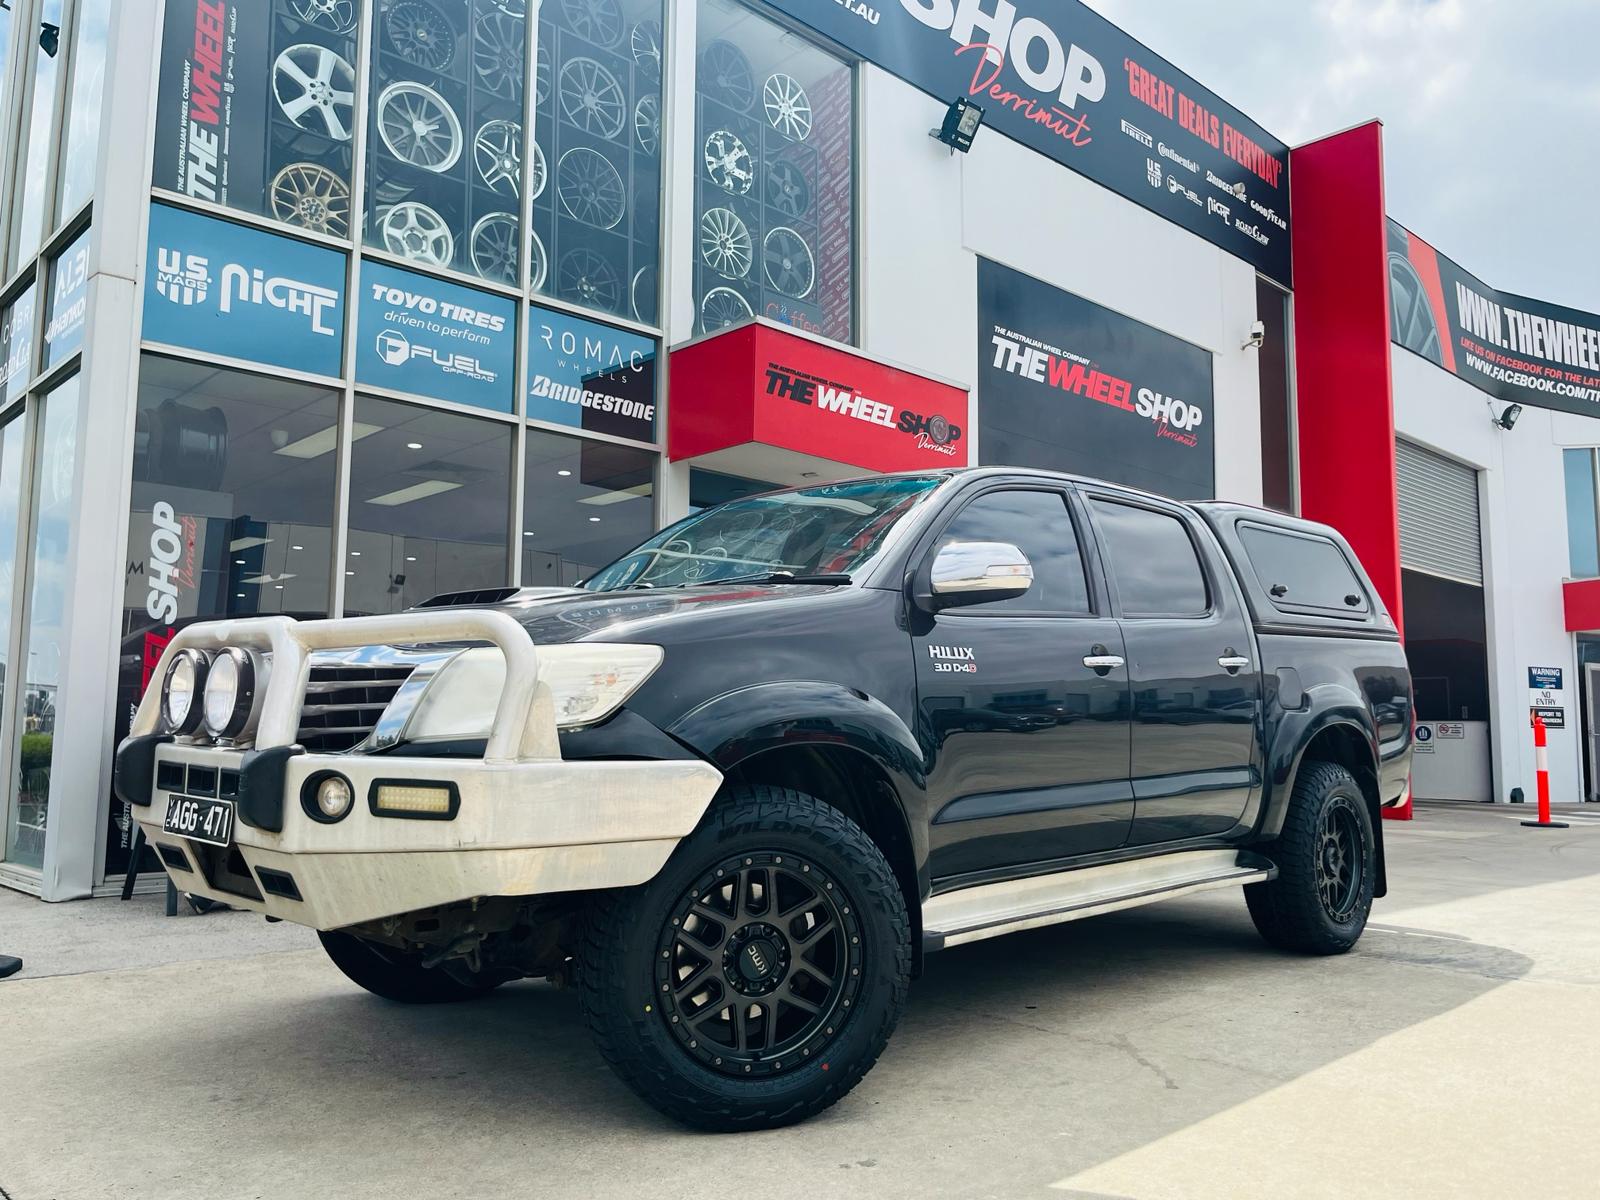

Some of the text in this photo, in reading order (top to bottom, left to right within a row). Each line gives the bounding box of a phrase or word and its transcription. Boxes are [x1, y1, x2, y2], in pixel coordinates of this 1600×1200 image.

[187, 0, 225, 202] THE WHEEL
[954, 43, 1092, 147] Derrimut
[177, 59, 191, 192] THE AUSTRALIAN WHEEL COMPANY
[1178, 92, 1220, 149] DEALS
[1121, 119, 1153, 148] PIRELLI
[1206, 170, 1247, 203] BRIDGESNE
[1250, 200, 1287, 231] GOODYEAR
[158, 247, 212, 284] U.S.
[158, 272, 207, 291] MAGS
[220, 263, 338, 336] NICHE
[372, 283, 506, 332] TOYO TIRES
[384, 310, 491, 345] driven to perform
[540, 325, 643, 373] ROMAC
[994, 325, 1006, 336] THE
[1006, 330, 1043, 349] AUSTRALIAN
[1042, 342, 1062, 356] WHEEL
[1062, 350, 1091, 366] COMPANY
[411, 344, 496, 376] FUEL
[442, 366, 495, 383] OFF-ROAD
[558, 359, 628, 384] WHEELS
[991, 335, 1202, 431] THE WHEEL SHOP
[1461, 336, 1600, 388] LIKE US ON FACEBOOK FOR THE LAT
[530, 375, 655, 422] BRIDGESTONE
[766, 369, 962, 445] THE WHEEL SHOP
[147, 501, 182, 625] SHOP
[928, 644, 975, 660] HILUX
[953, 663, 977, 673] D-4D
[1531, 668, 1560, 676] WARNING
[1541, 690, 1551, 698] NO
[747, 945, 768, 975] KMC
